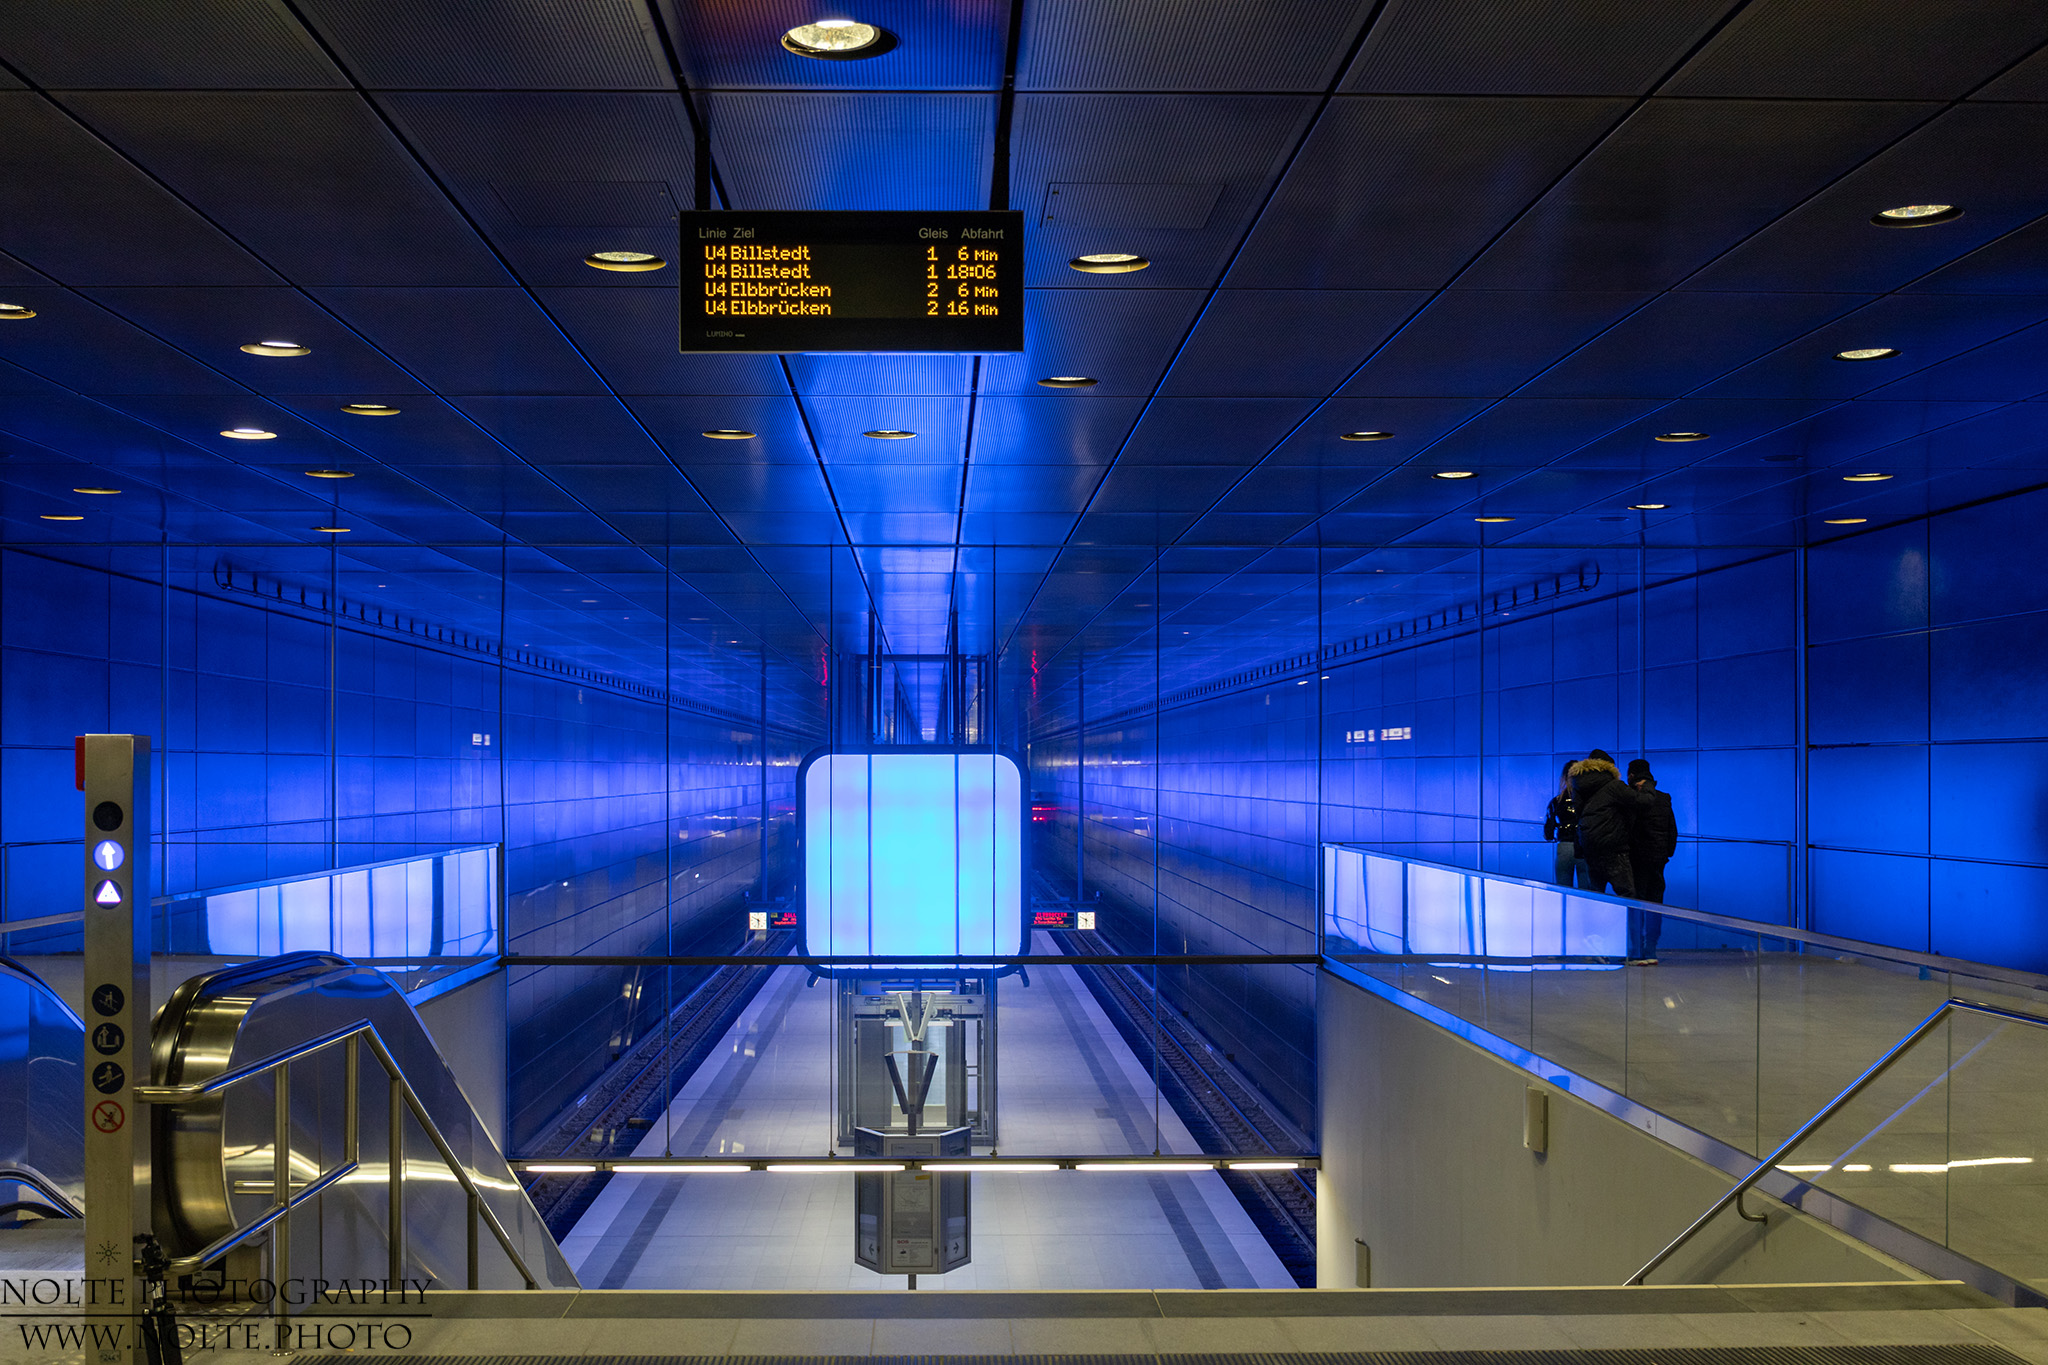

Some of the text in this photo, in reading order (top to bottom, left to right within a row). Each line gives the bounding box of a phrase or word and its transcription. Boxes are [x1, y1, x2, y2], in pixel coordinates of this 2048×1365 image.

[699, 227, 1004, 239] Linie Ziel Gleis Abfahrt
[705, 245, 999, 261] U4 Billstedt 1 6 Min
[705, 264, 997, 279] U4 Billstedt 1 18:06
[705, 282, 999, 297] U4 Elbbrücken 2 6 Min
[705, 300, 999, 315] U4 Elbbrücken 2 16 Min
